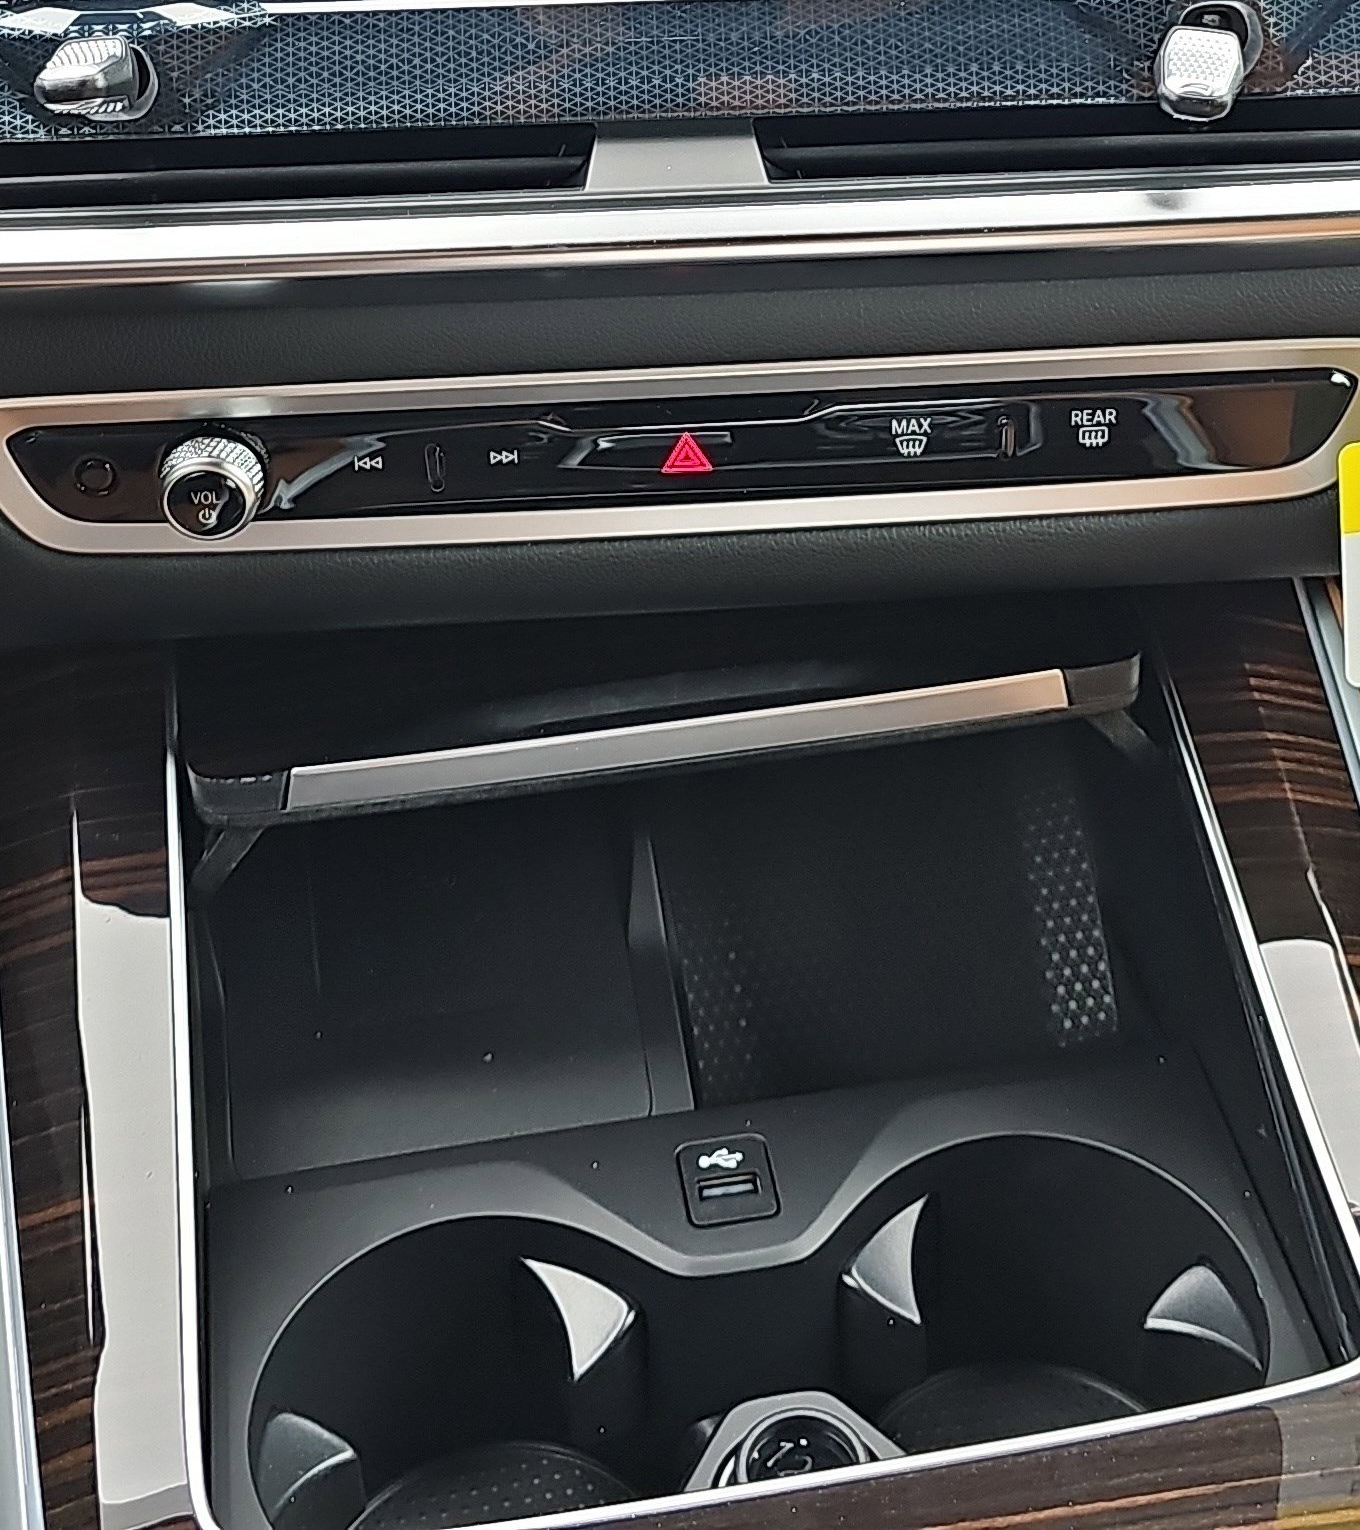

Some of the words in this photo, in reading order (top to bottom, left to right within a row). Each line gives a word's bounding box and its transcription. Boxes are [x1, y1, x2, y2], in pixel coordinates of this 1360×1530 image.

[1070, 408, 1117, 427] REAR
[890, 418, 932, 436] MAX
[190, 490, 221, 506] VOL
